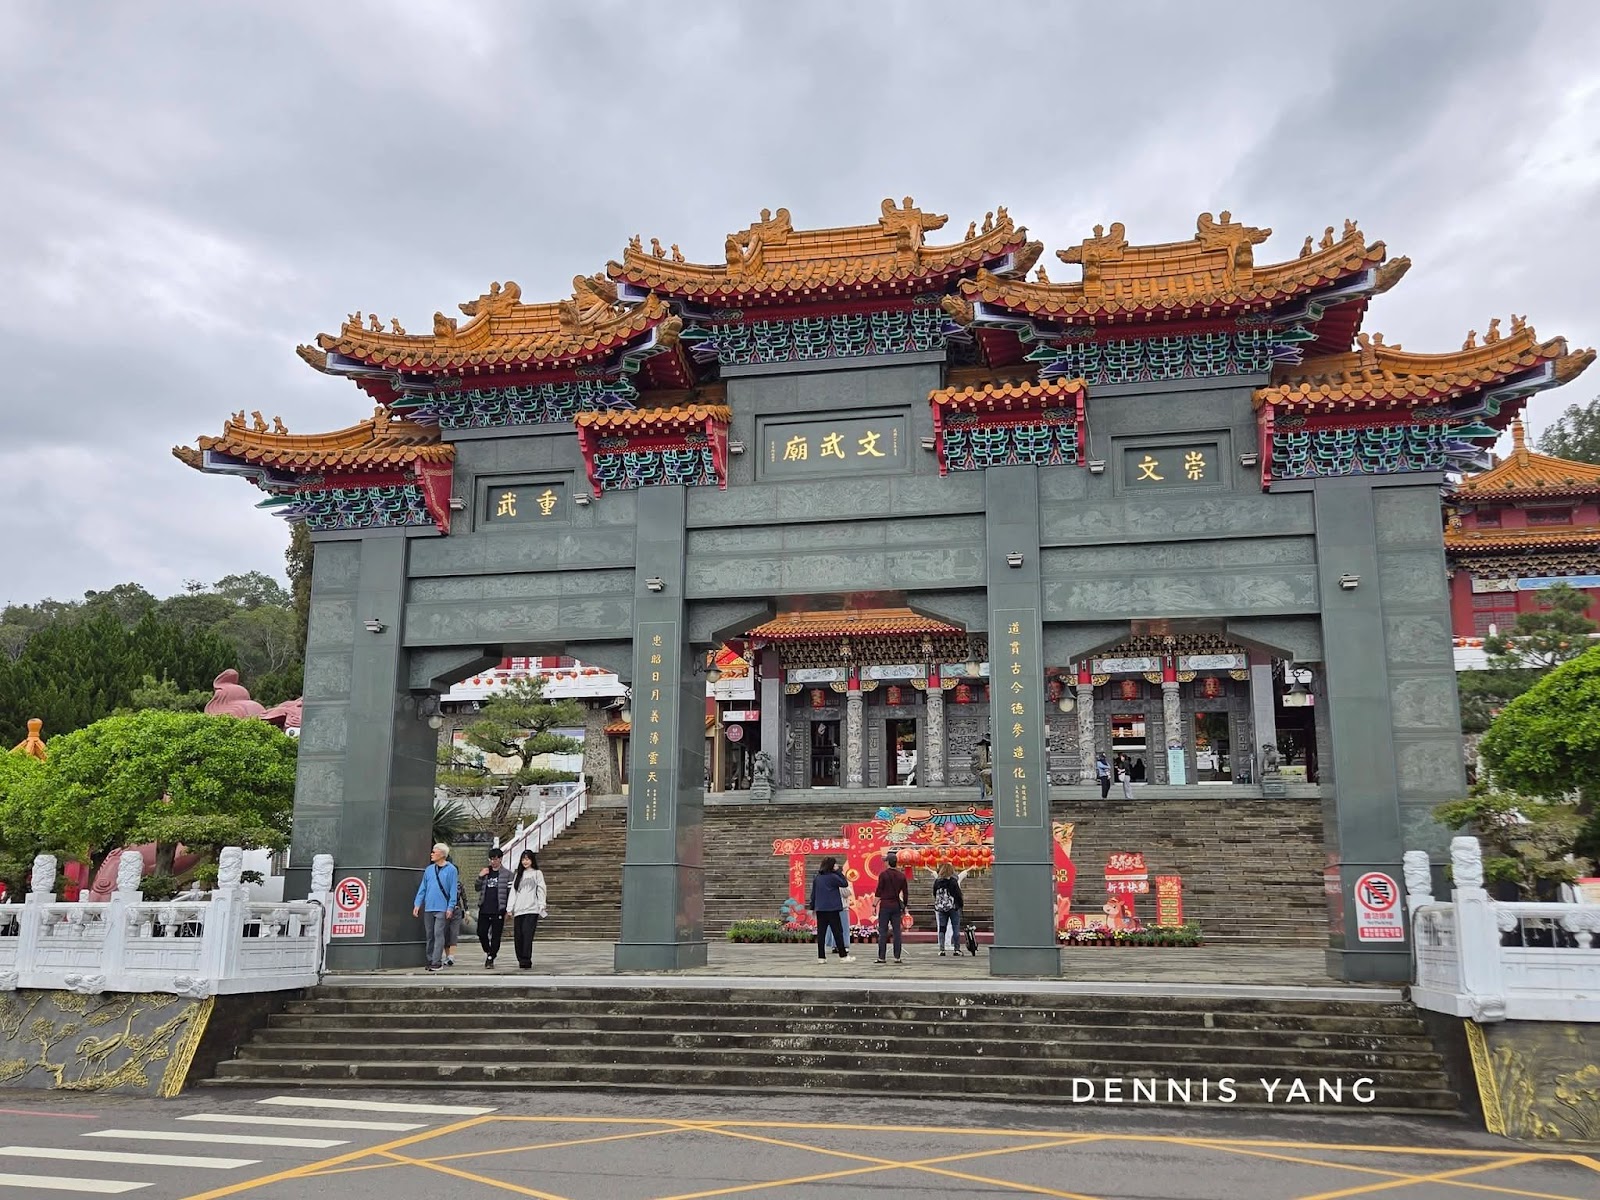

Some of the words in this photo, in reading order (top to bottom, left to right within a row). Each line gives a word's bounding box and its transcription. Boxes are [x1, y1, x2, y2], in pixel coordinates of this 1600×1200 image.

[783, 430, 886, 461] 文武廟
[1136, 451, 1206, 480] 崇文
[496, 489, 558, 517] 重武
[772, 838, 812, 855] 2026
